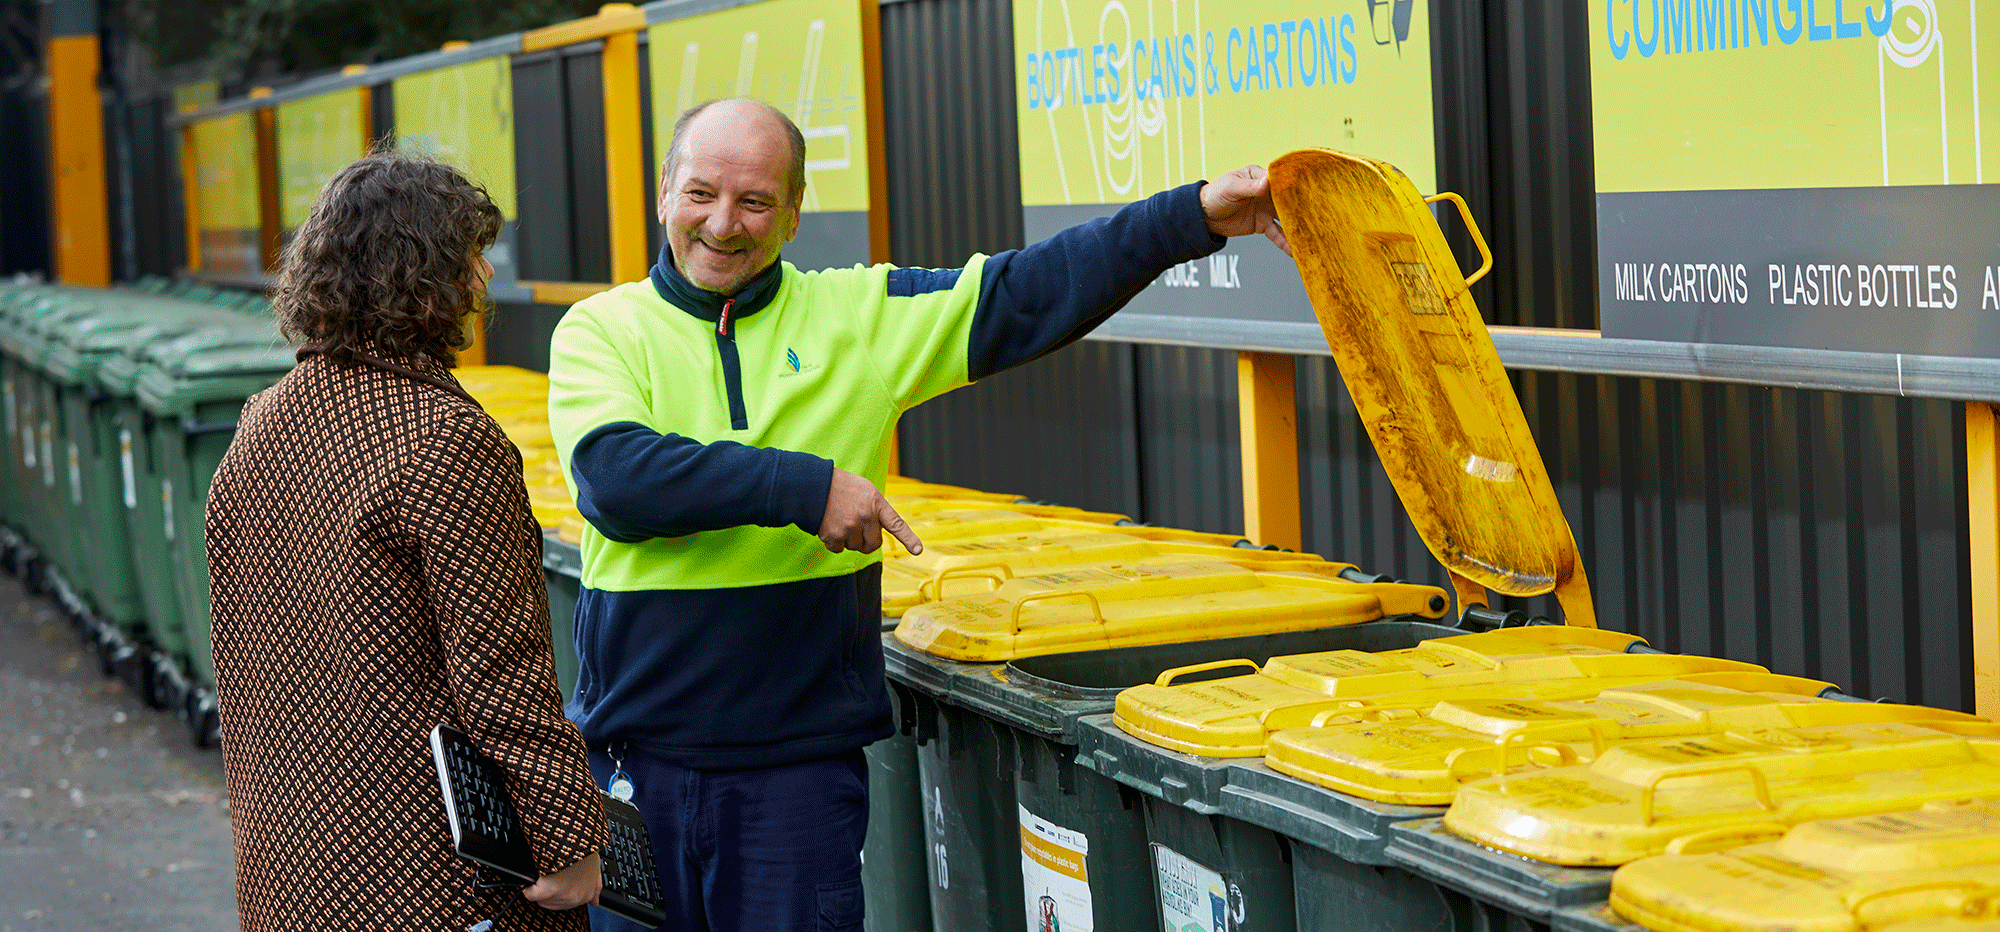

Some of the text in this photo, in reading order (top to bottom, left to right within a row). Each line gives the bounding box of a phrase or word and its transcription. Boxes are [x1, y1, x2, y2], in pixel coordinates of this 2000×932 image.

[1027, 13, 1357, 110] BOTTLES CANS & CARTONS
[1209, 254, 1241, 288] MILK
[1615, 262, 2000, 310] MILK CARTONS PLASTIC BOTTLES A
[934, 842, 949, 890] 16
